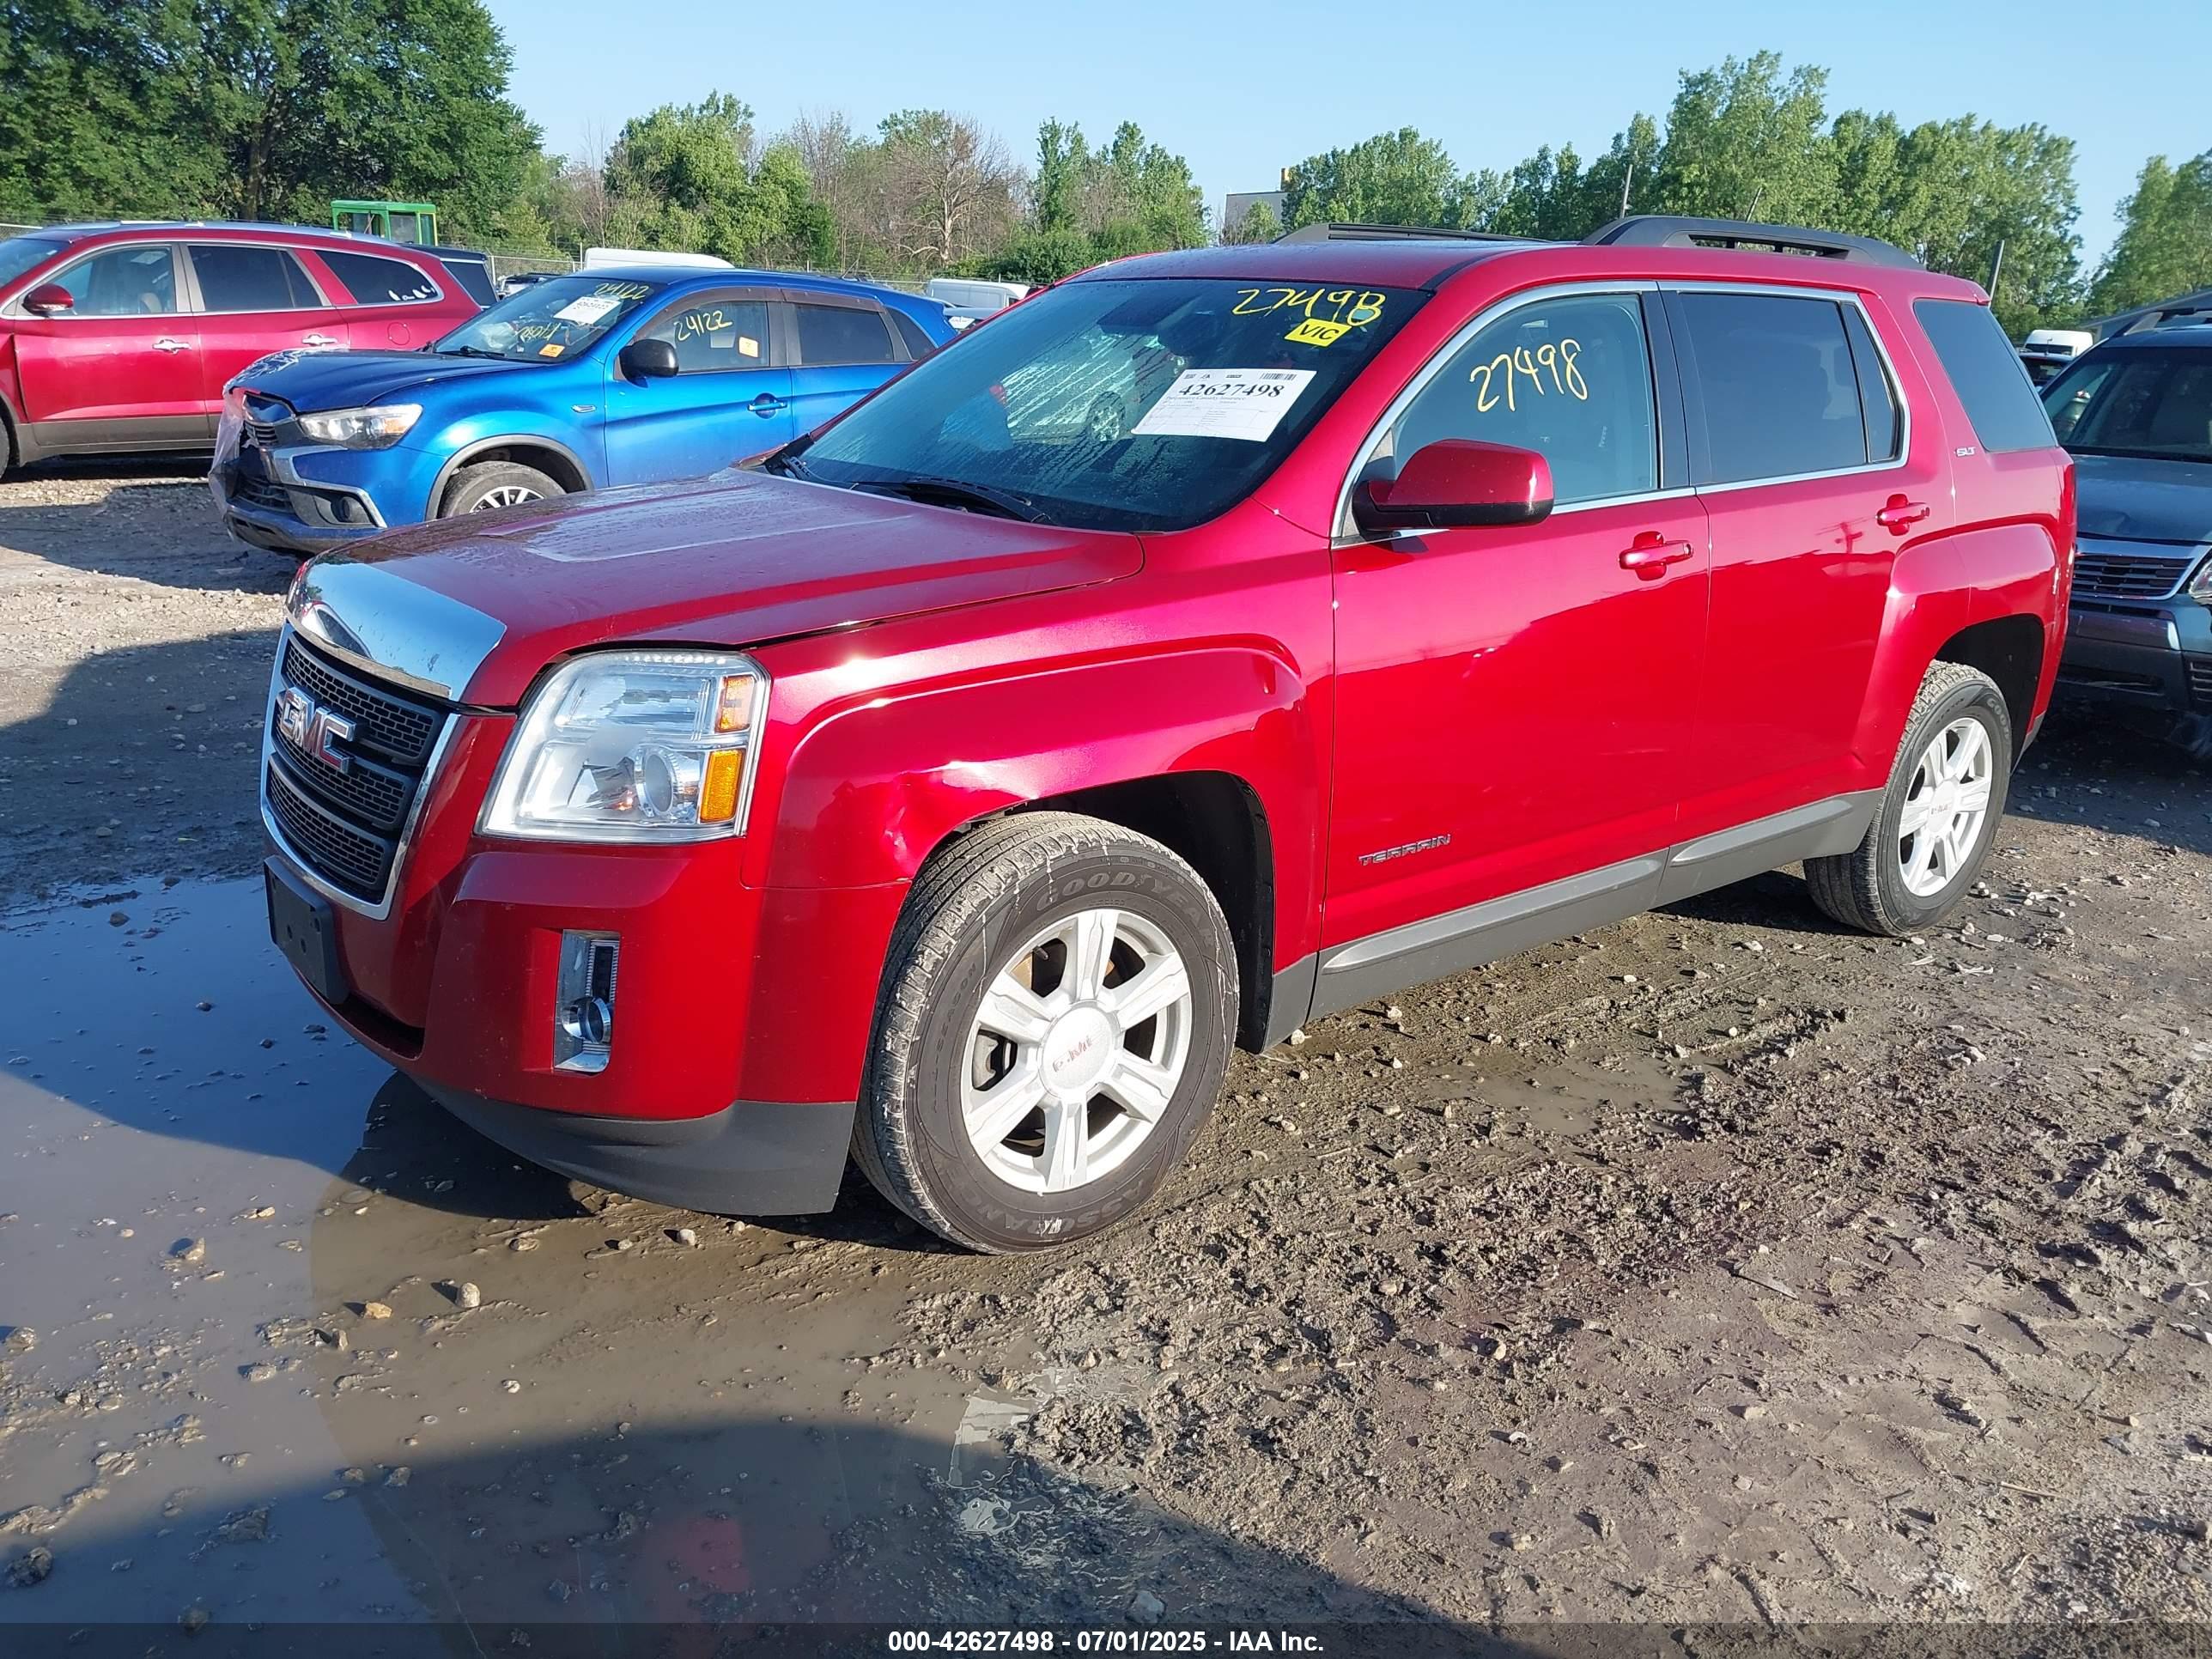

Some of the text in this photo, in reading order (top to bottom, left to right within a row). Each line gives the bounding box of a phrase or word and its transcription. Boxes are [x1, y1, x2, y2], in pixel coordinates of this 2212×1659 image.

[674, 310, 733, 341] 24122
[1299, 324, 1340, 340] VIC
[1179, 383, 1285, 398] 42627498
[1469, 338, 1589, 412] 27498
[1955, 447, 1976, 457] SLT
[279, 687, 357, 774] GMC
[1358, 834, 1451, 866] TERRAIN
